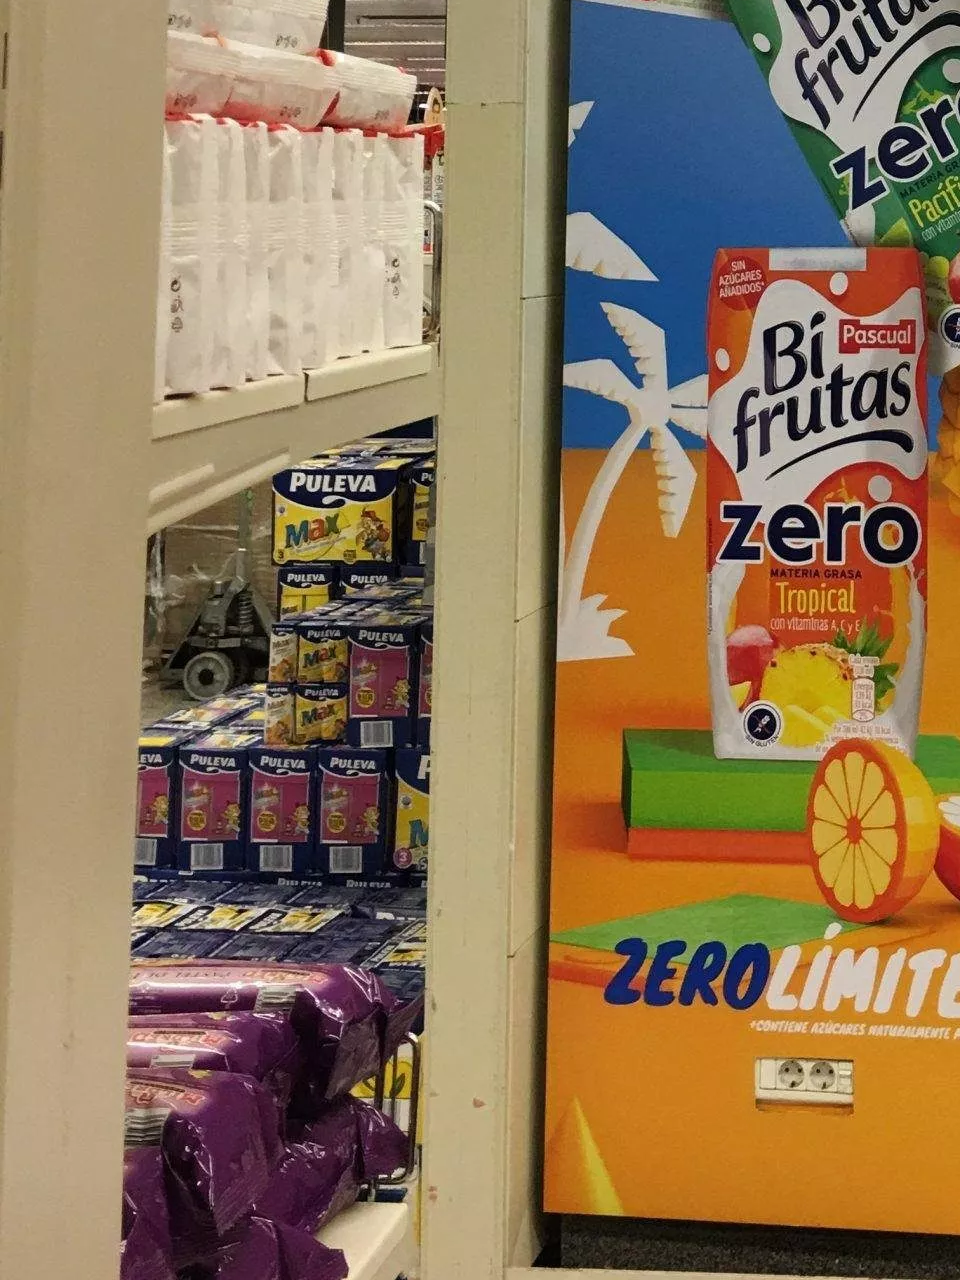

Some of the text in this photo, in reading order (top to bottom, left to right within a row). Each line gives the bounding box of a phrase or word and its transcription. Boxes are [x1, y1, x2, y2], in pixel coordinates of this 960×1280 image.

[900, 171, 944, 198] MATERIA
[922, 226, 937, 241] con
[731, 260, 745, 271] SIN
[719, 270, 762, 286] AZÚCARES
[843, 324, 911, 344] Pascual
[733, 361, 911, 473] frutas
[289, 472, 376, 492] PULEVA
[285, 513, 340, 548] Max
[719, 503, 920, 565] zero
[287, 573, 325, 582] PULEVA
[351, 575, 387, 583] PULEVA
[770, 568, 862, 579] MATERIA GRASA
[776, 580, 856, 616] Tropical
[770, 618, 785, 629] con
[307, 630, 341, 638] PULEVA
[359, 629, 404, 642] PULEVA
[305, 689, 339, 697] PULEVA
[140, 754, 162, 763] EVA
[190, 754, 236, 768] PULEVA
[260, 756, 306, 770] PULEVA
[330, 758, 376, 770] PULEVA
[811, 1020, 866, 1036] AZÚCARES
[868, 1025, 950, 1039] NATURALMENTE
